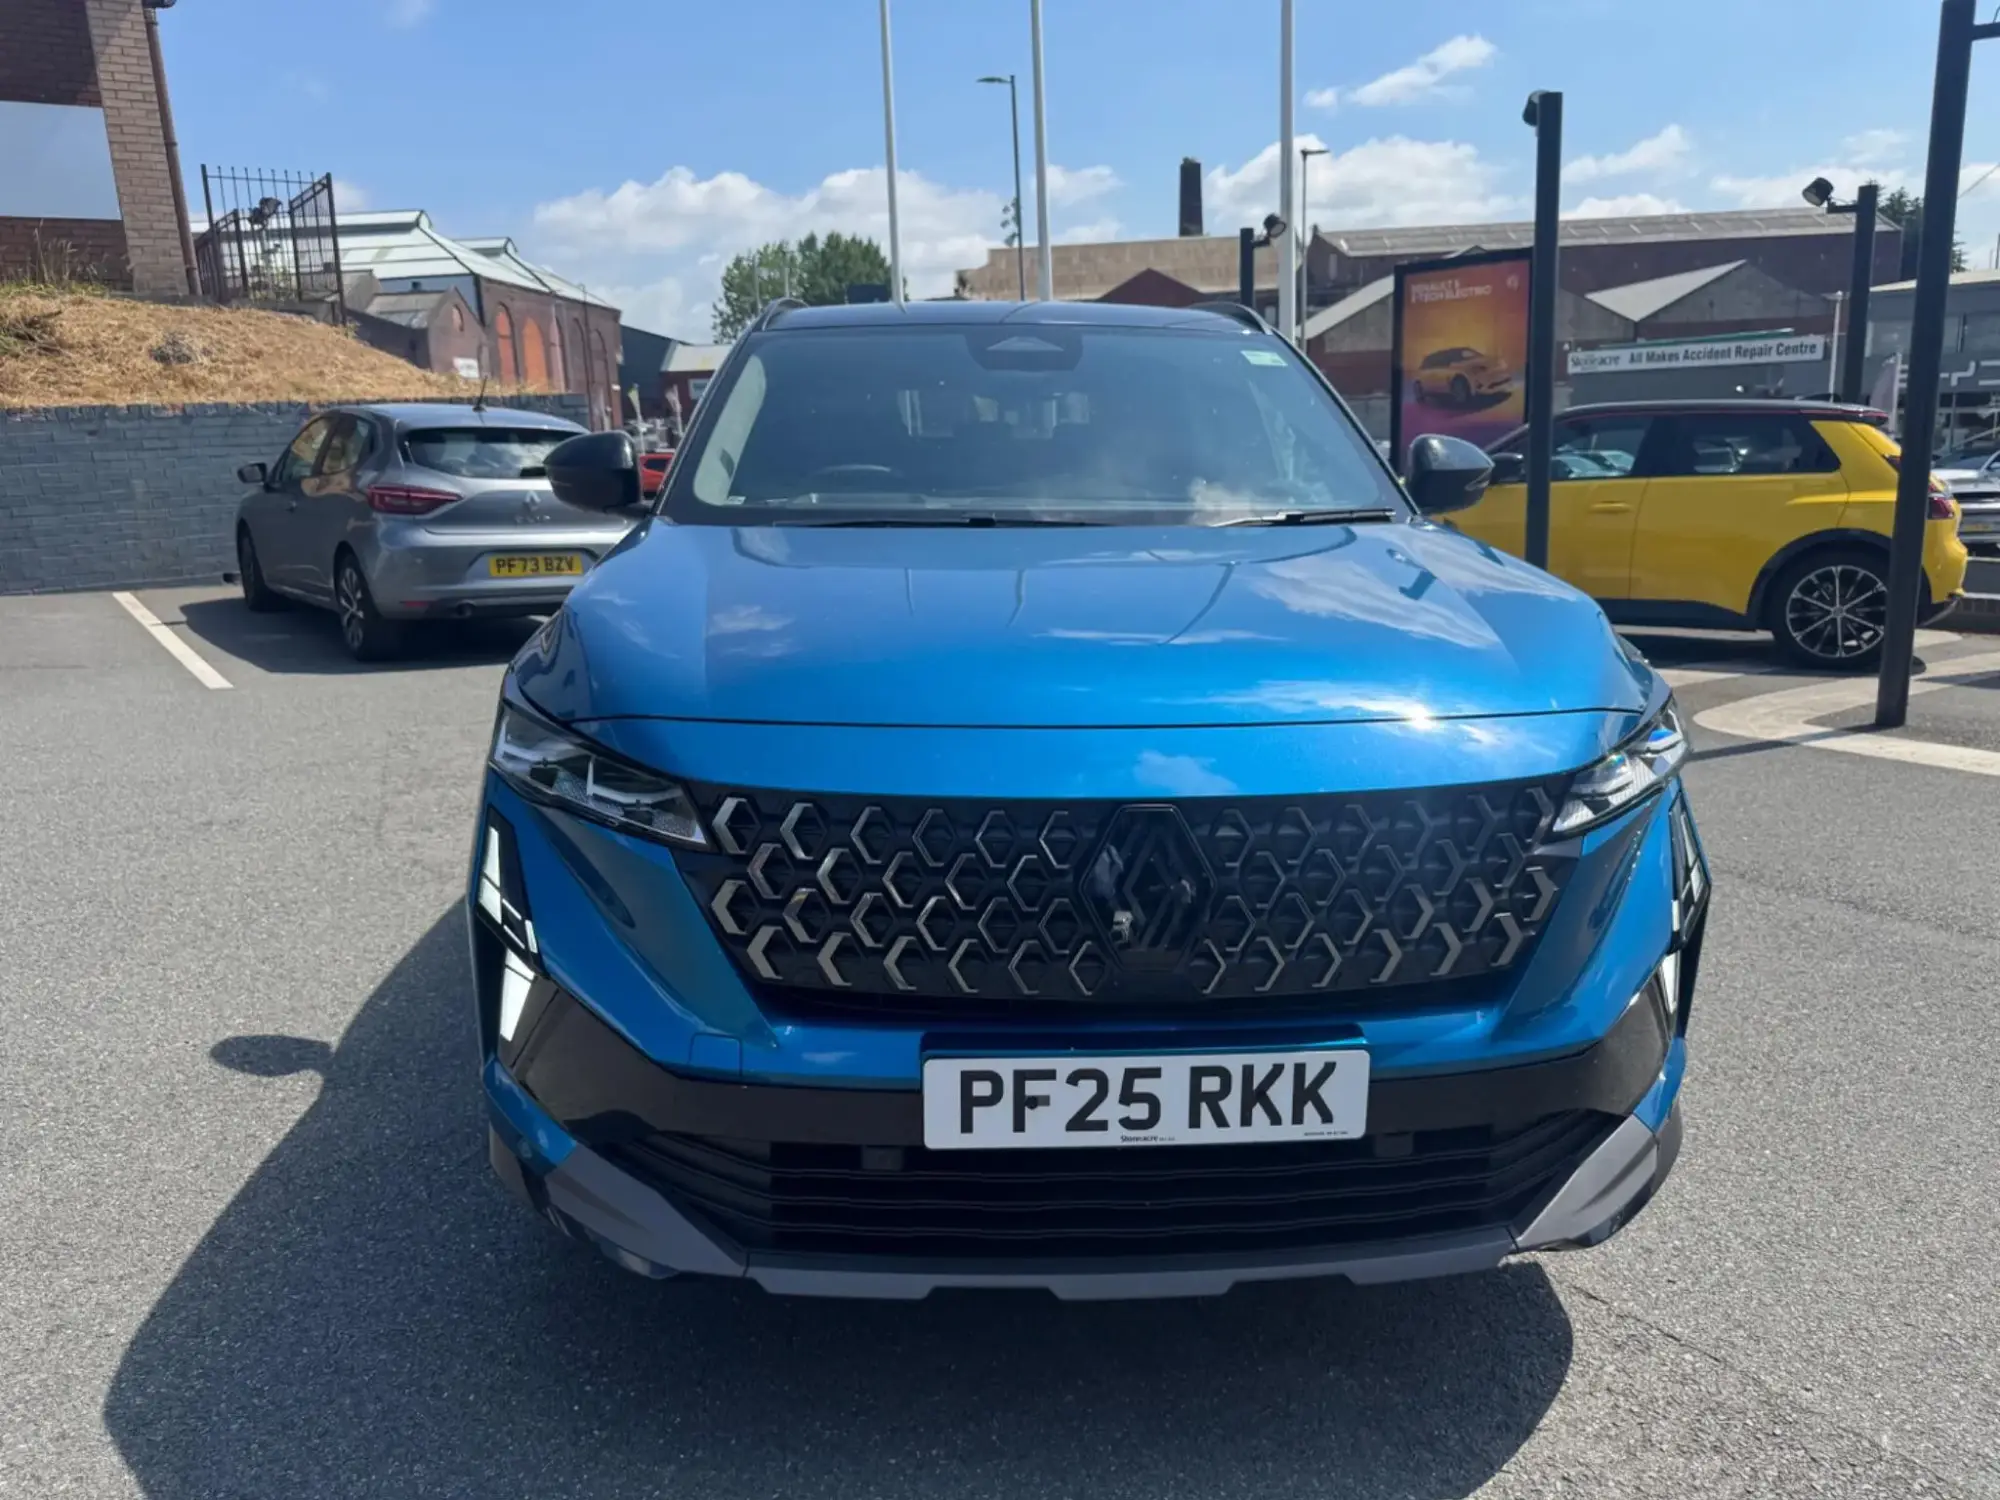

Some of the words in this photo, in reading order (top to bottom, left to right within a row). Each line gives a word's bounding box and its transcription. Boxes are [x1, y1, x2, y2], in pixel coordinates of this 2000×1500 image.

[1628, 351, 1643, 364] All
[1646, 350, 1680, 363] Makes
[1682, 347, 1732, 361] Accident
[1734, 344, 1773, 359] Repair
[1775, 341, 1817, 355] Centre
[495, 557, 540, 574] PF73
[543, 556, 574, 572] BZV
[959, 1066, 1162, 1134] PF25
[1187, 1060, 1337, 1130] RKK
